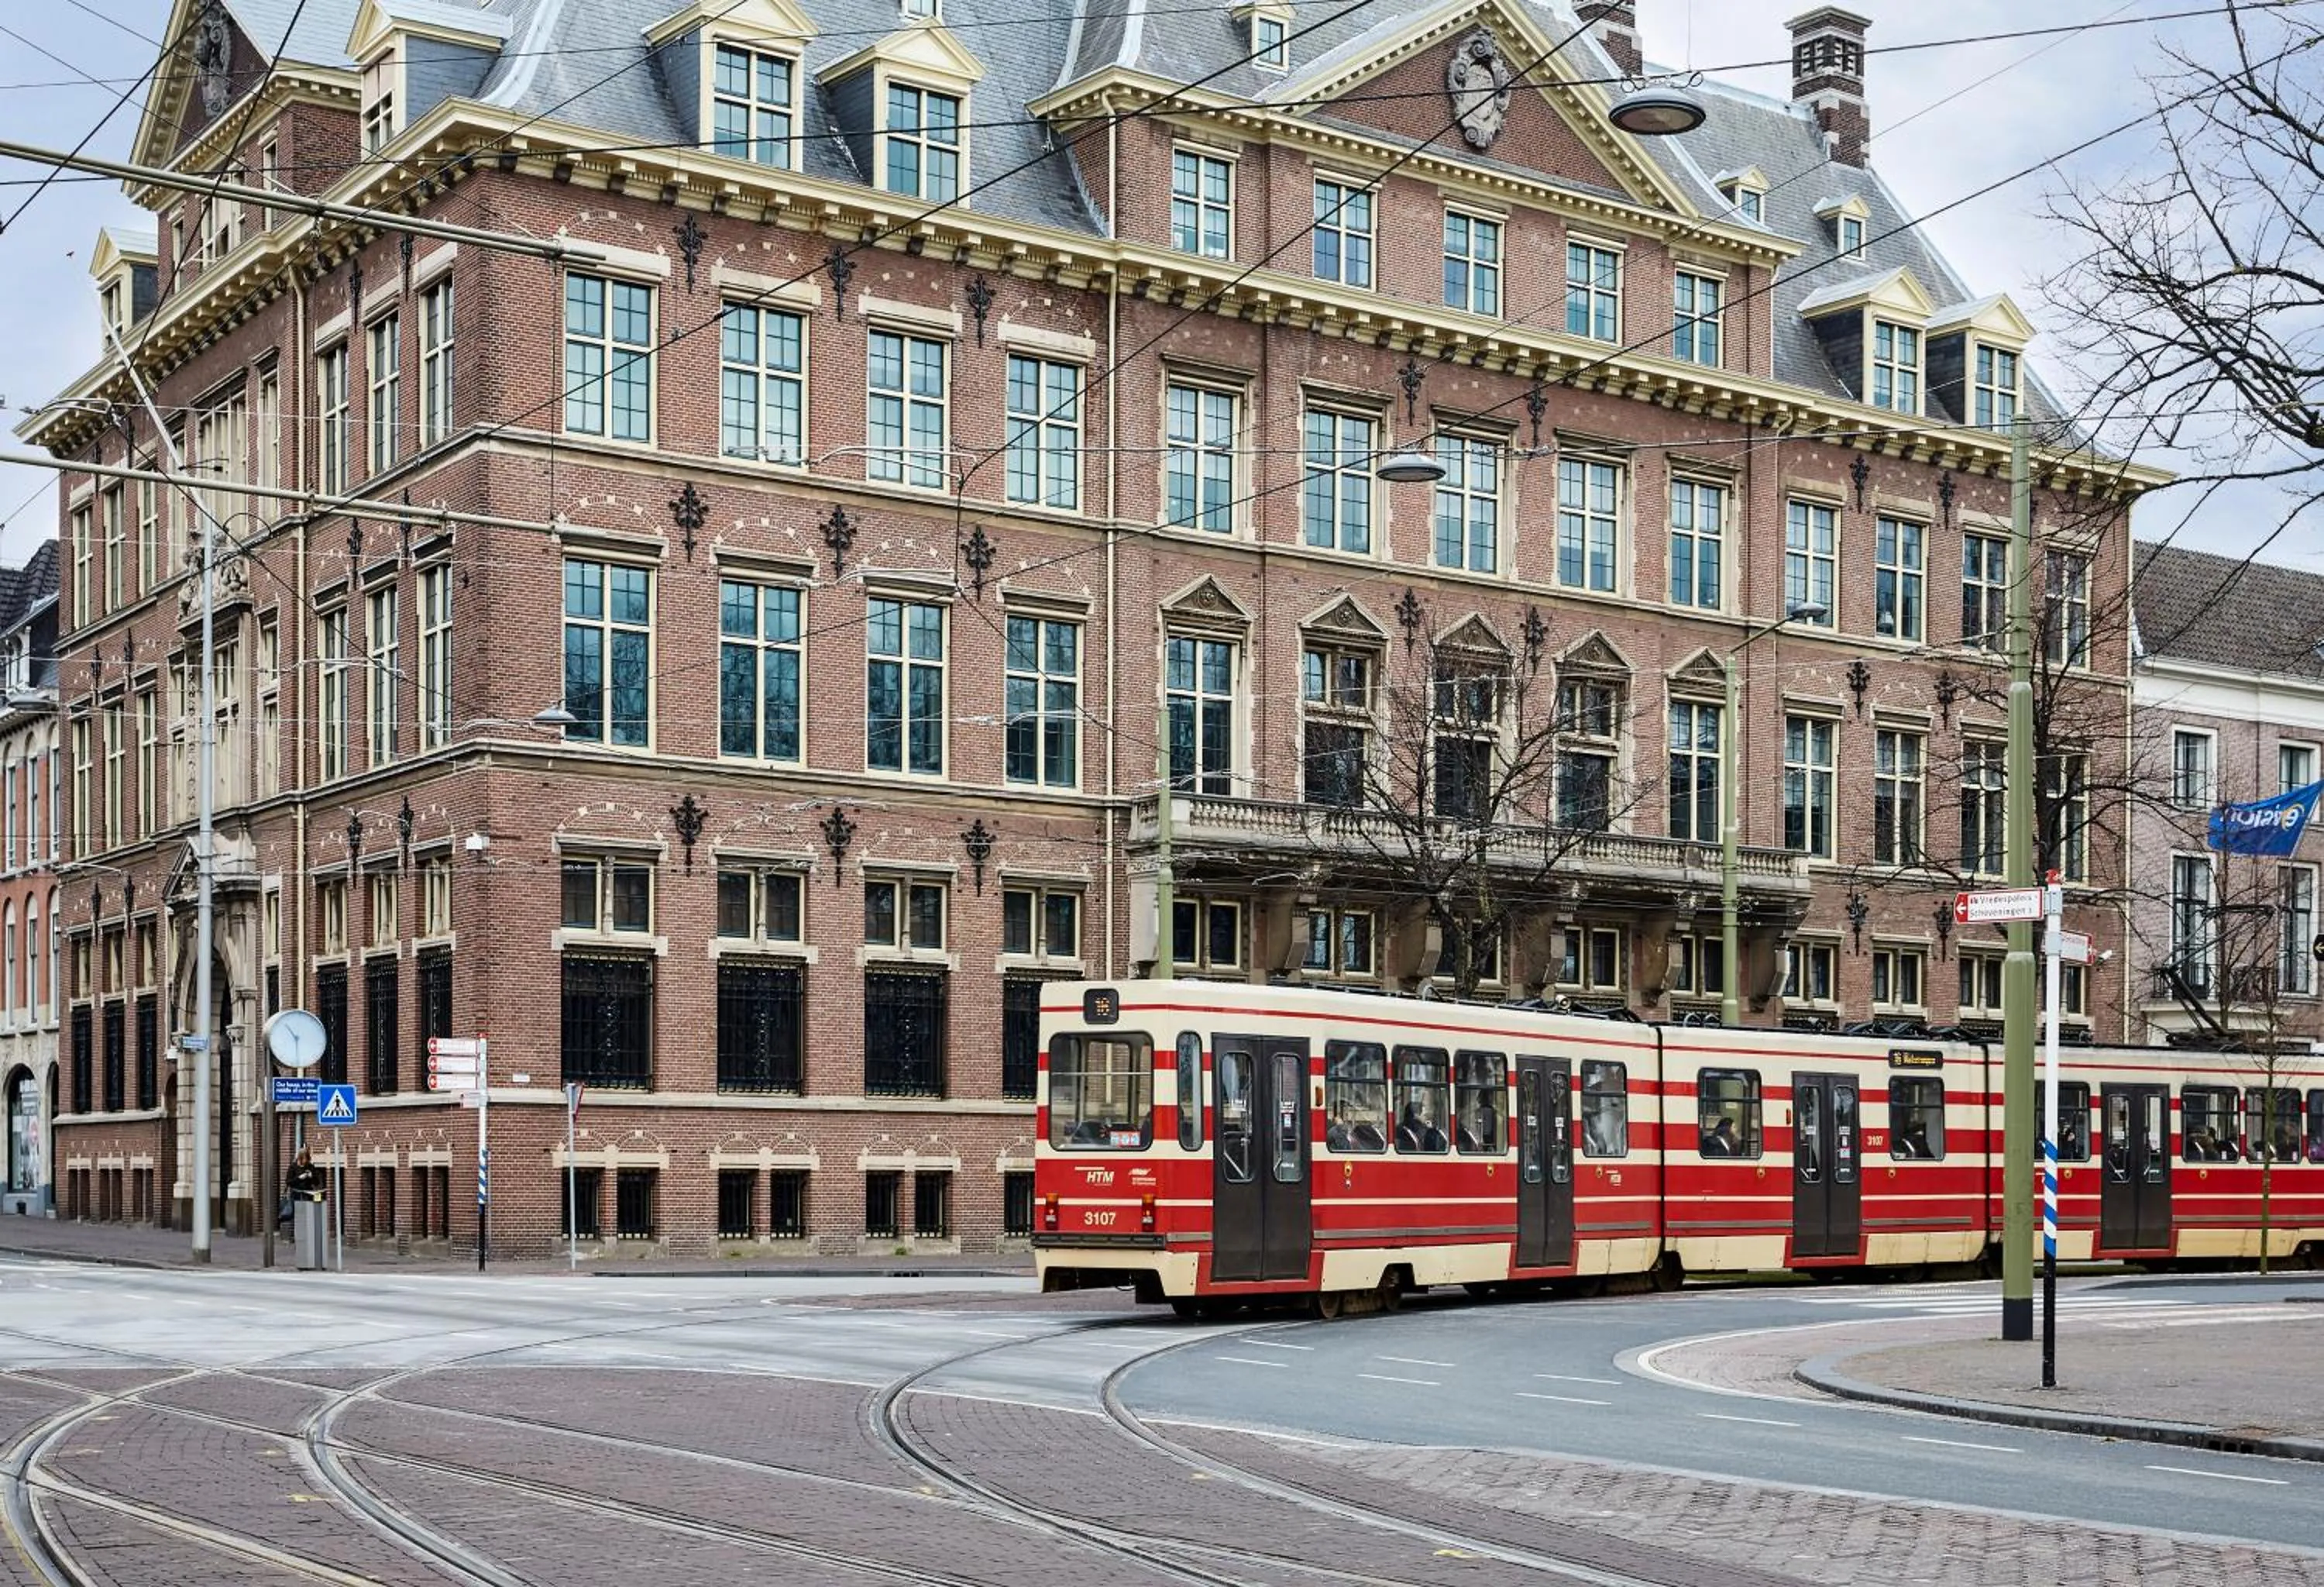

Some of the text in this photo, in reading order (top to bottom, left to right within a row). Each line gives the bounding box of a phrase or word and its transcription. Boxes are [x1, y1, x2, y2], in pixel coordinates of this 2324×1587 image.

[1970, 907, 2026, 917] Scheveningen
[1086, 1171, 1115, 1183] HTM
[1085, 1211, 1116, 1225] 3107
